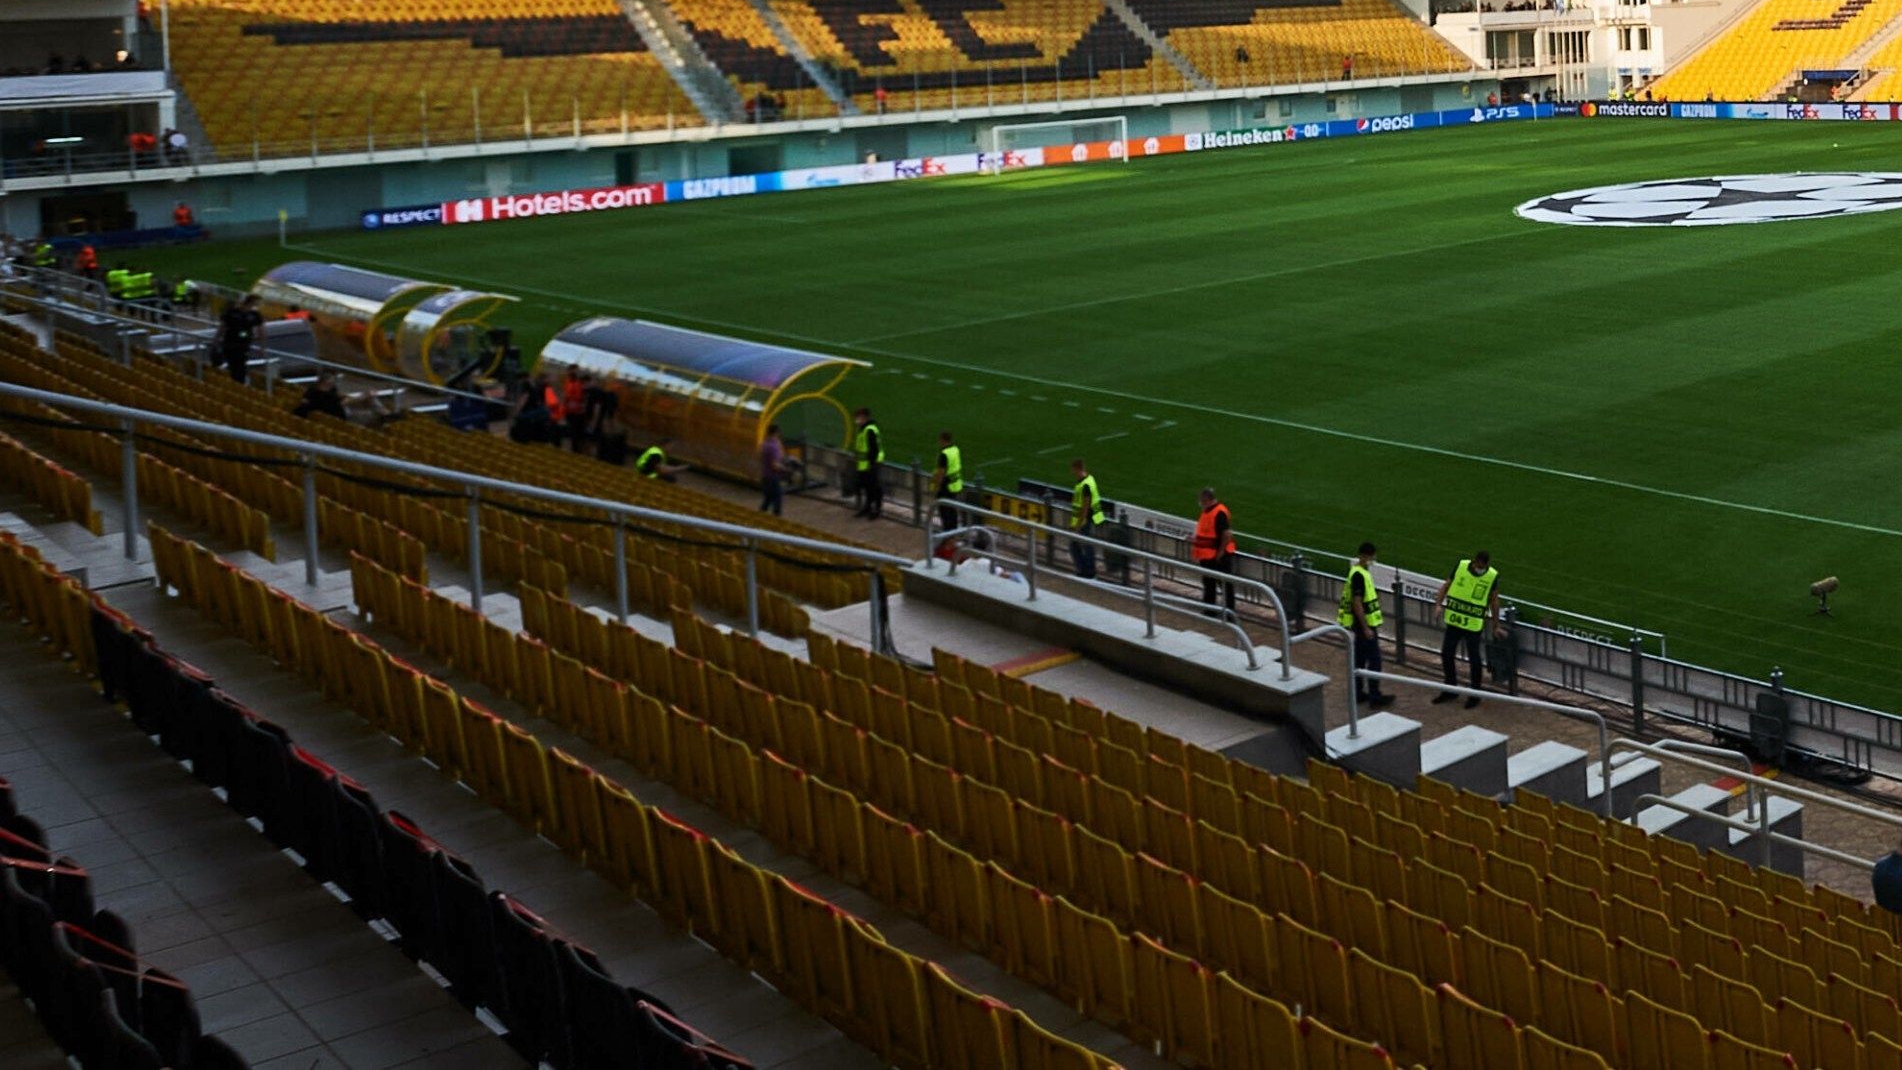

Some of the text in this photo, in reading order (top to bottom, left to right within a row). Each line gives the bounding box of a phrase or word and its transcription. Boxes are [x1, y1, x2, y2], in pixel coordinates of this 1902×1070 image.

[1599, 103, 1667, 117] mastercard
[1680, 103, 1718, 118] GAZPROM
[1786, 103, 1819, 120] FedEx
[1842, 103, 1877, 120] FedEx
[1370, 113, 1414, 134] pepsi
[1203, 128, 1283, 149] Heineken
[894, 156, 947, 178] FedEx
[682, 174, 757, 200] GAZPROM
[491, 187, 651, 219] Hotels.com
[382, 208, 441, 225] RESPECT
